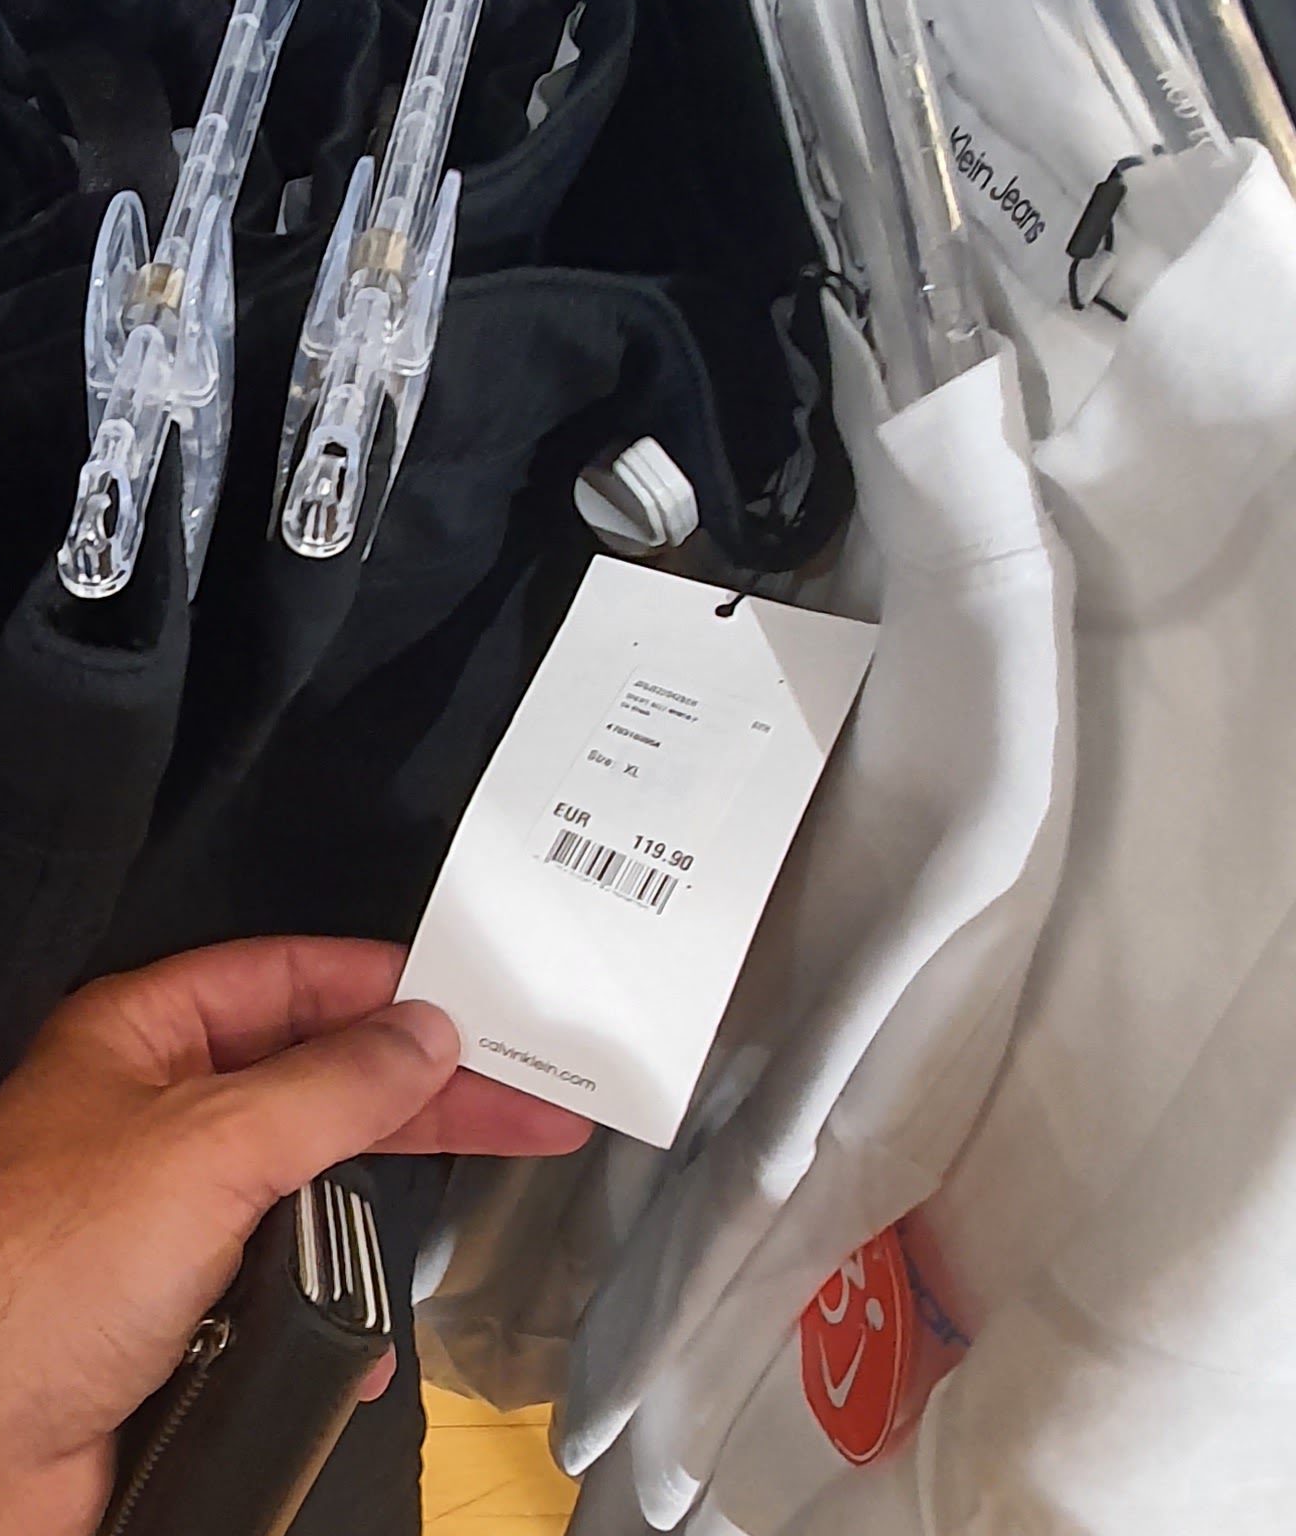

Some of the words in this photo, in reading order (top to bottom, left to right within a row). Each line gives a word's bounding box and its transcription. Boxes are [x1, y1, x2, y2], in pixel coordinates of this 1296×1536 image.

[950, 125, 994, 191] Klein
[989, 175, 1046, 244] Jeans
[623, 762, 640, 778] XL
[553, 802, 592, 828] EUR
[632, 835, 695, 871] 119.90
[479, 1037, 597, 1092] calvinklein.com
